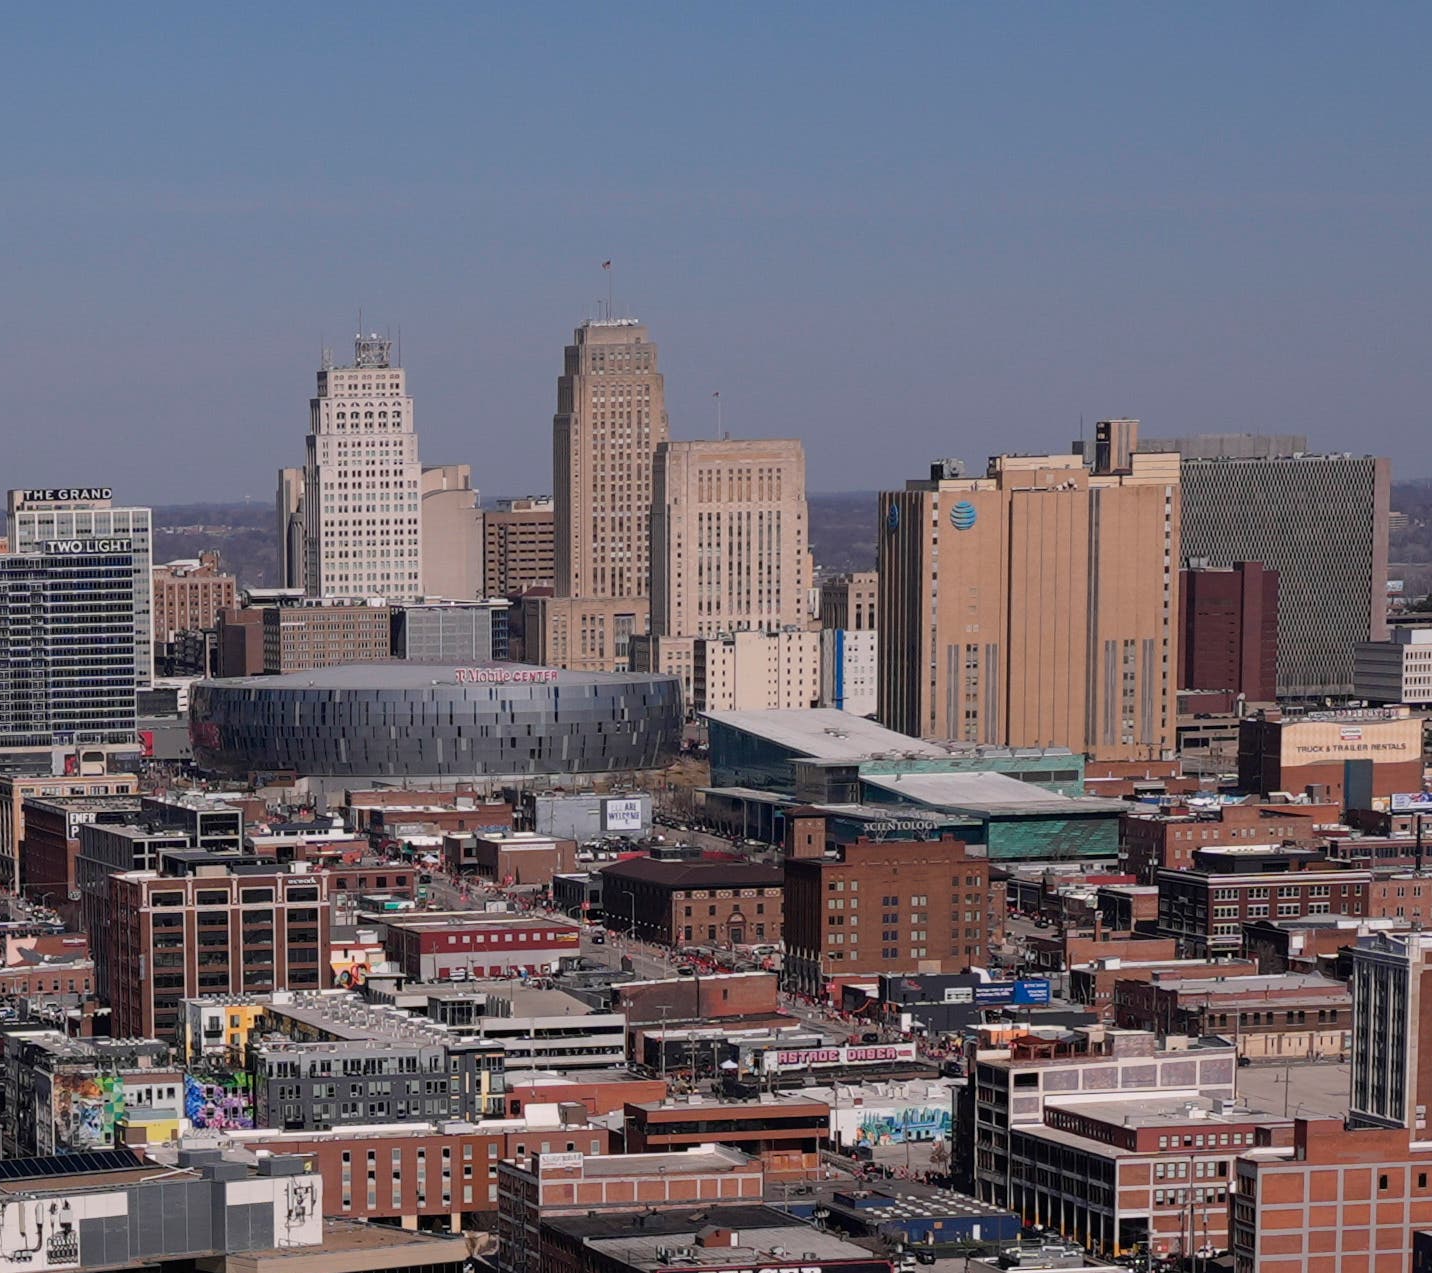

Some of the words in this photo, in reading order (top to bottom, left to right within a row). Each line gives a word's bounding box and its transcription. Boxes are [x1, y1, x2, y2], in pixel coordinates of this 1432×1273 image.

[25, 490, 49, 501] THE
[53, 489, 113, 500] GRAND
[48, 542, 82, 554] TWO
[85, 541, 131, 553] LIGHT
[512, 670, 559, 682] CENTER
[1296, 745, 1323, 754] TRUCK
[1333, 744, 1369, 753] TRAILER
[1371, 743, 1407, 752] RENTALS
[864, 821, 939, 832] SCIENTOLOGY
